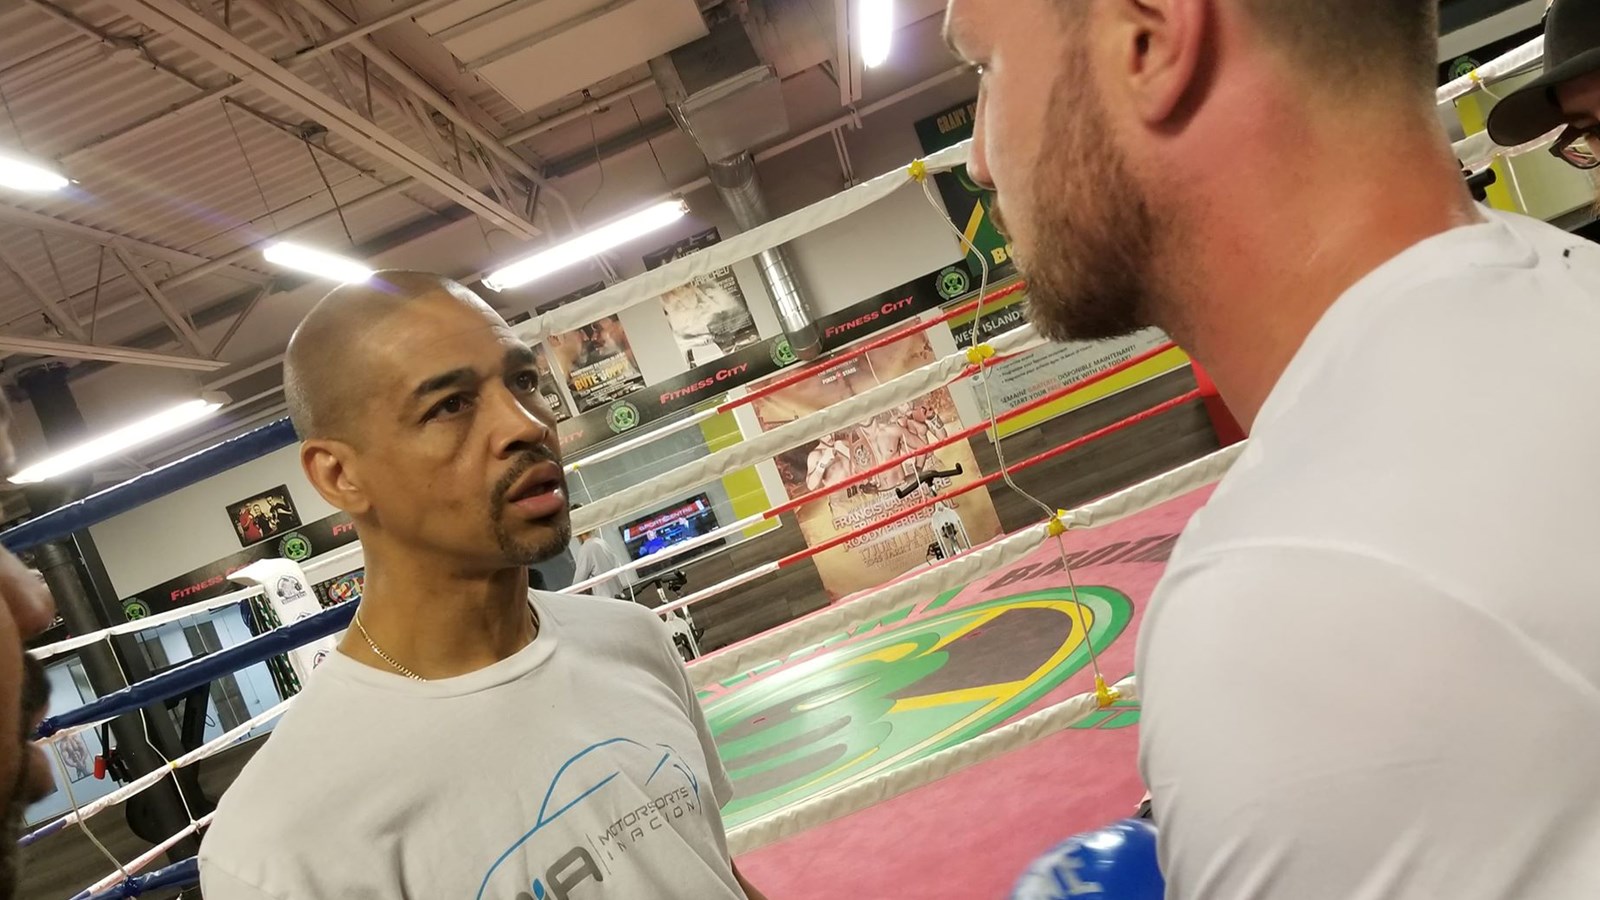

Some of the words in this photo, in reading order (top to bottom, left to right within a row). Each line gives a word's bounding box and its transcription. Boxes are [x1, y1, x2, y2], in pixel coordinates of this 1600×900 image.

[825, 310, 880, 338] FITNESS
[881, 296, 914, 316] CITY
[982, 311, 1021, 332] ISLAND
[660, 376, 714, 405] FITNESS
[715, 362, 749, 382] CITY
[833, 503, 883, 530] FRANCIS
[170, 574, 224, 602] FITNESS
